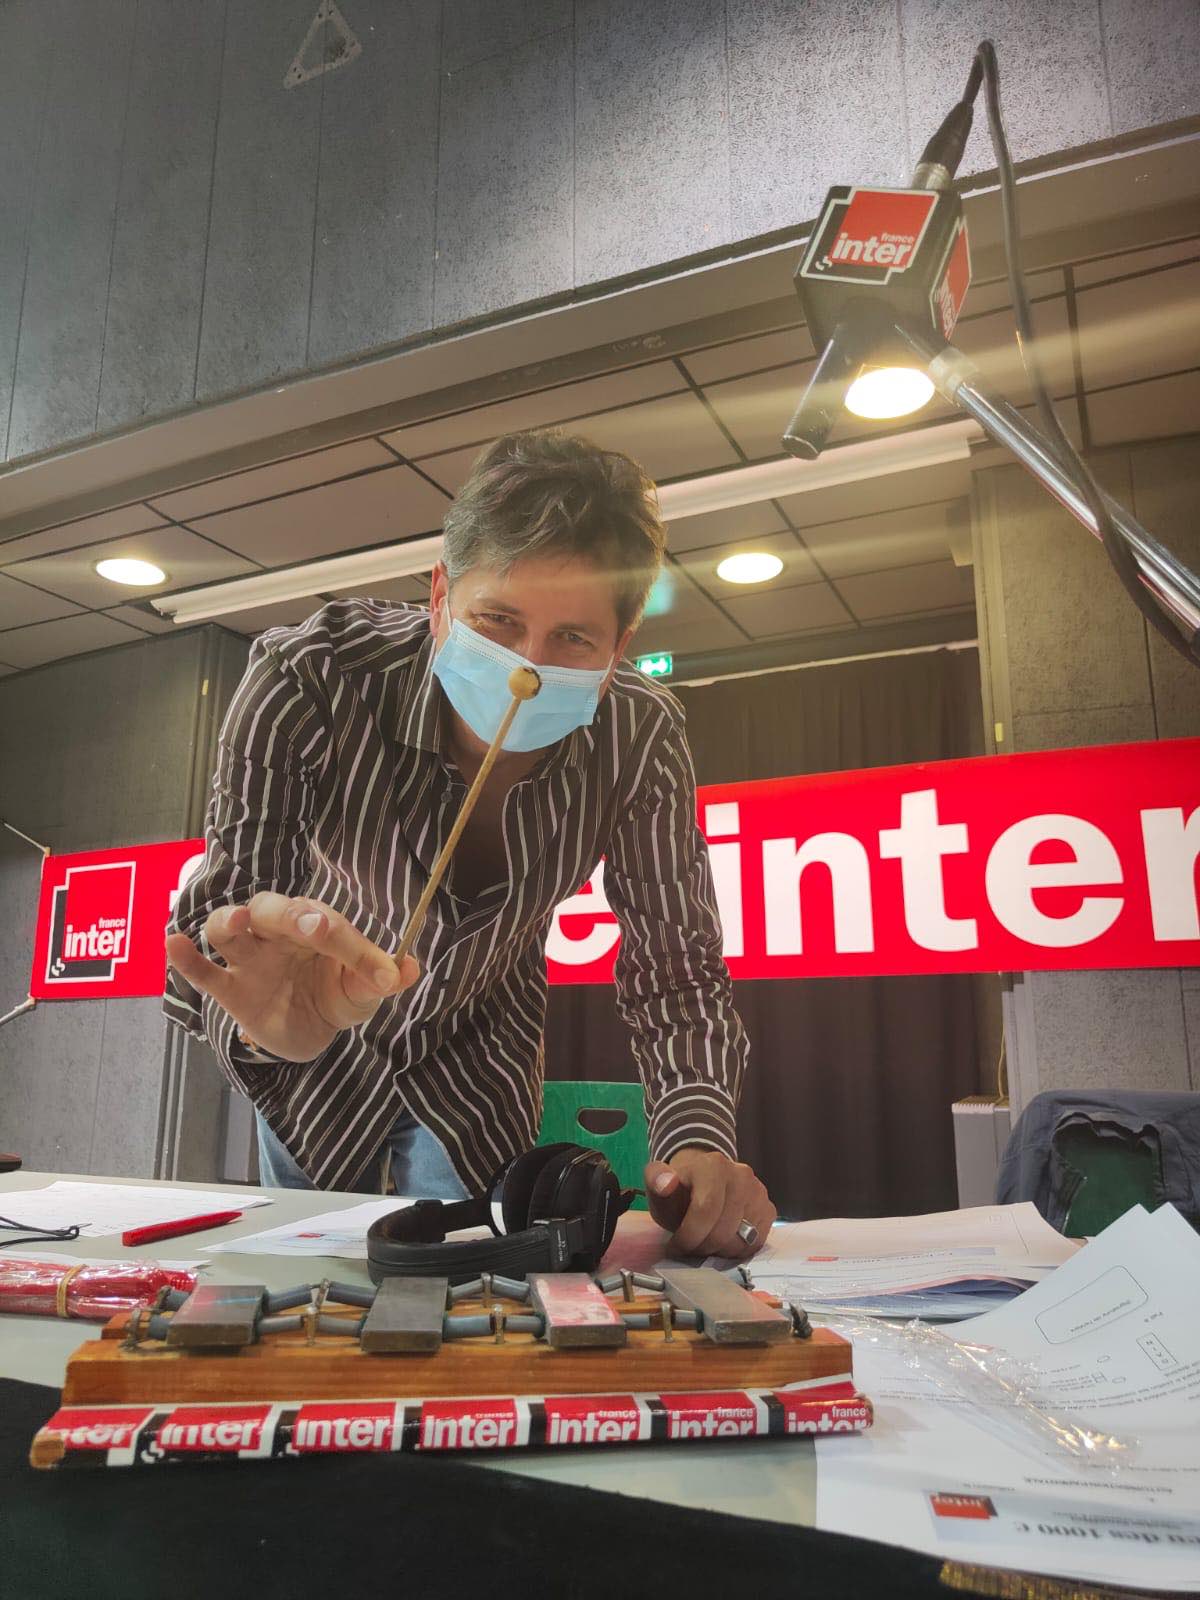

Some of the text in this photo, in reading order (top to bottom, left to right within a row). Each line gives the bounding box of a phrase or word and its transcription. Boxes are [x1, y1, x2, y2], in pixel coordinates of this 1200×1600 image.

[832, 233, 912, 264] inter
[881, 232, 914, 242] france
[704, 788, 1200, 957] inter
[98, 917, 126, 928] france
[64, 924, 126, 958] inter
[671, 1411, 754, 1438] inter
[718, 1407, 753, 1417] france
[831, 1406, 866, 1416] france
[299, 1417, 392, 1447] inter
[423, 1415, 514, 1447] inter
[551, 1412, 637, 1444] inter
[1037, 1523, 1102, 1539] 1000
